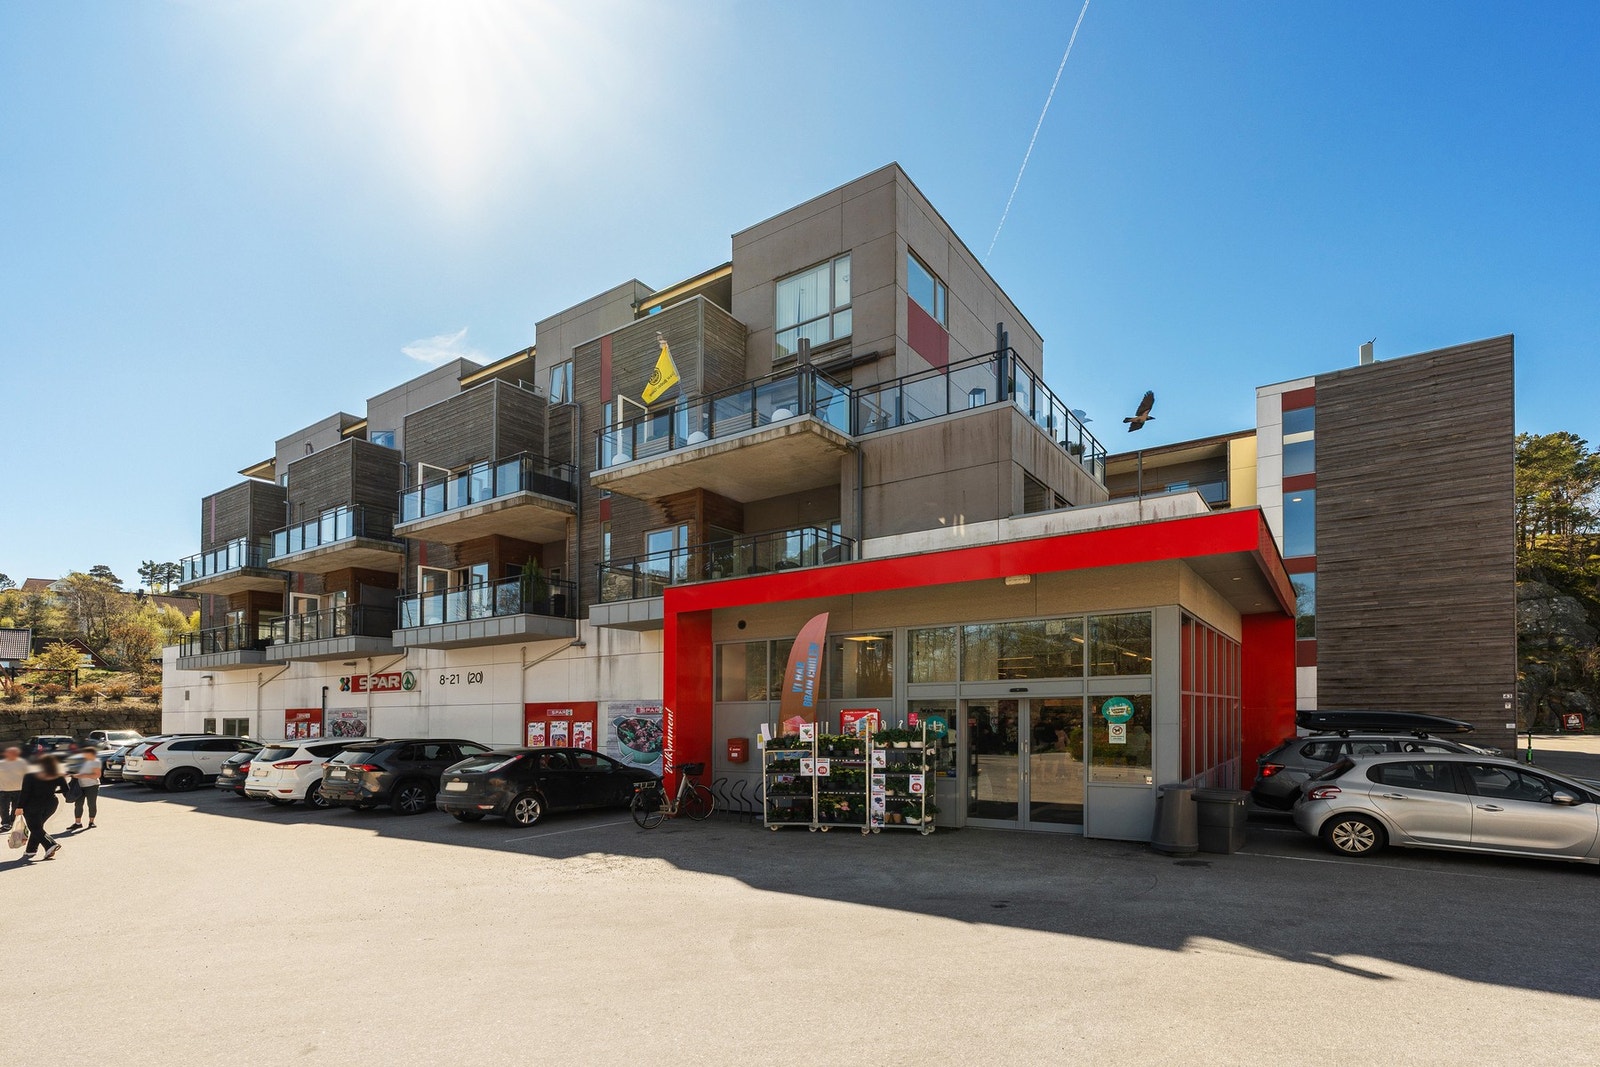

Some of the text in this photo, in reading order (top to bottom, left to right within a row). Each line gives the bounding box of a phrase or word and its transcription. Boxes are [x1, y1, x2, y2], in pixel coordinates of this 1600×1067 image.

[358, 675, 400, 690] SPAR
[439, 671, 484, 685] 8-21 (20)
[803, 680, 814, 707] BRAIN
